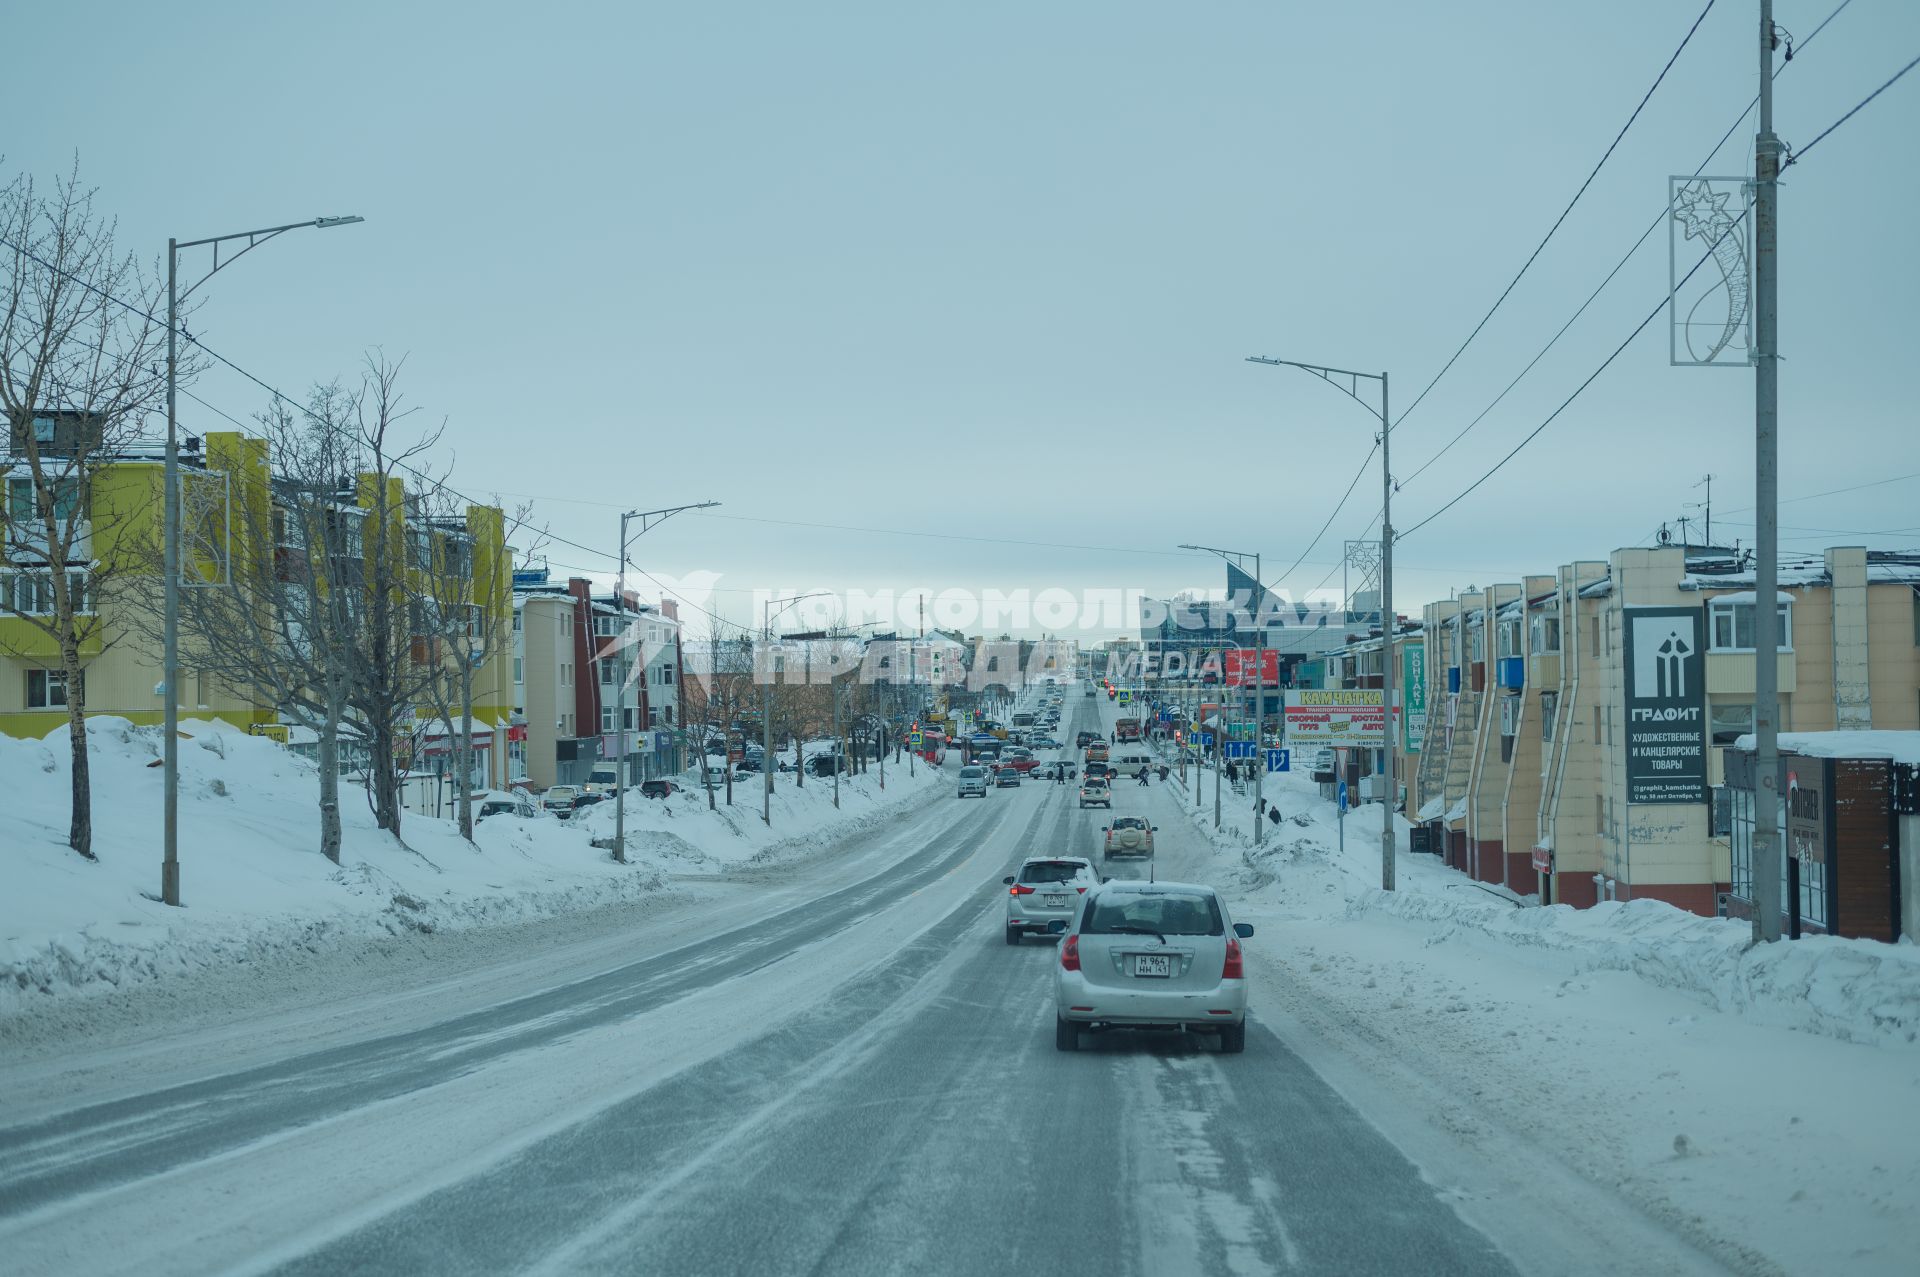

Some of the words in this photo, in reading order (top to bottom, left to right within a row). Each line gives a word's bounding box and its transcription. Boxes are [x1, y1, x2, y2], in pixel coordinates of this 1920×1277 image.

[1412, 652, 1422, 706] КОНТАКТ
[1300, 691, 1383, 705] КАМЧАТКА
[1287, 714, 1331, 723] СБОРНЫЙ
[1631, 707, 1700, 721] ГРАФИТ
[1298, 723, 1320, 731] ГРУЗ
[1632, 732, 1700, 742] ХУДОЖЕСТВЕННЫЕ
[1632, 747, 1639, 757] И
[1640, 746, 1701, 757] КАНЦЕЛЯРСКИЕ
[1651, 759, 1683, 770] ТОВАРЫ
[1149, 957, 1165, 965] 964
